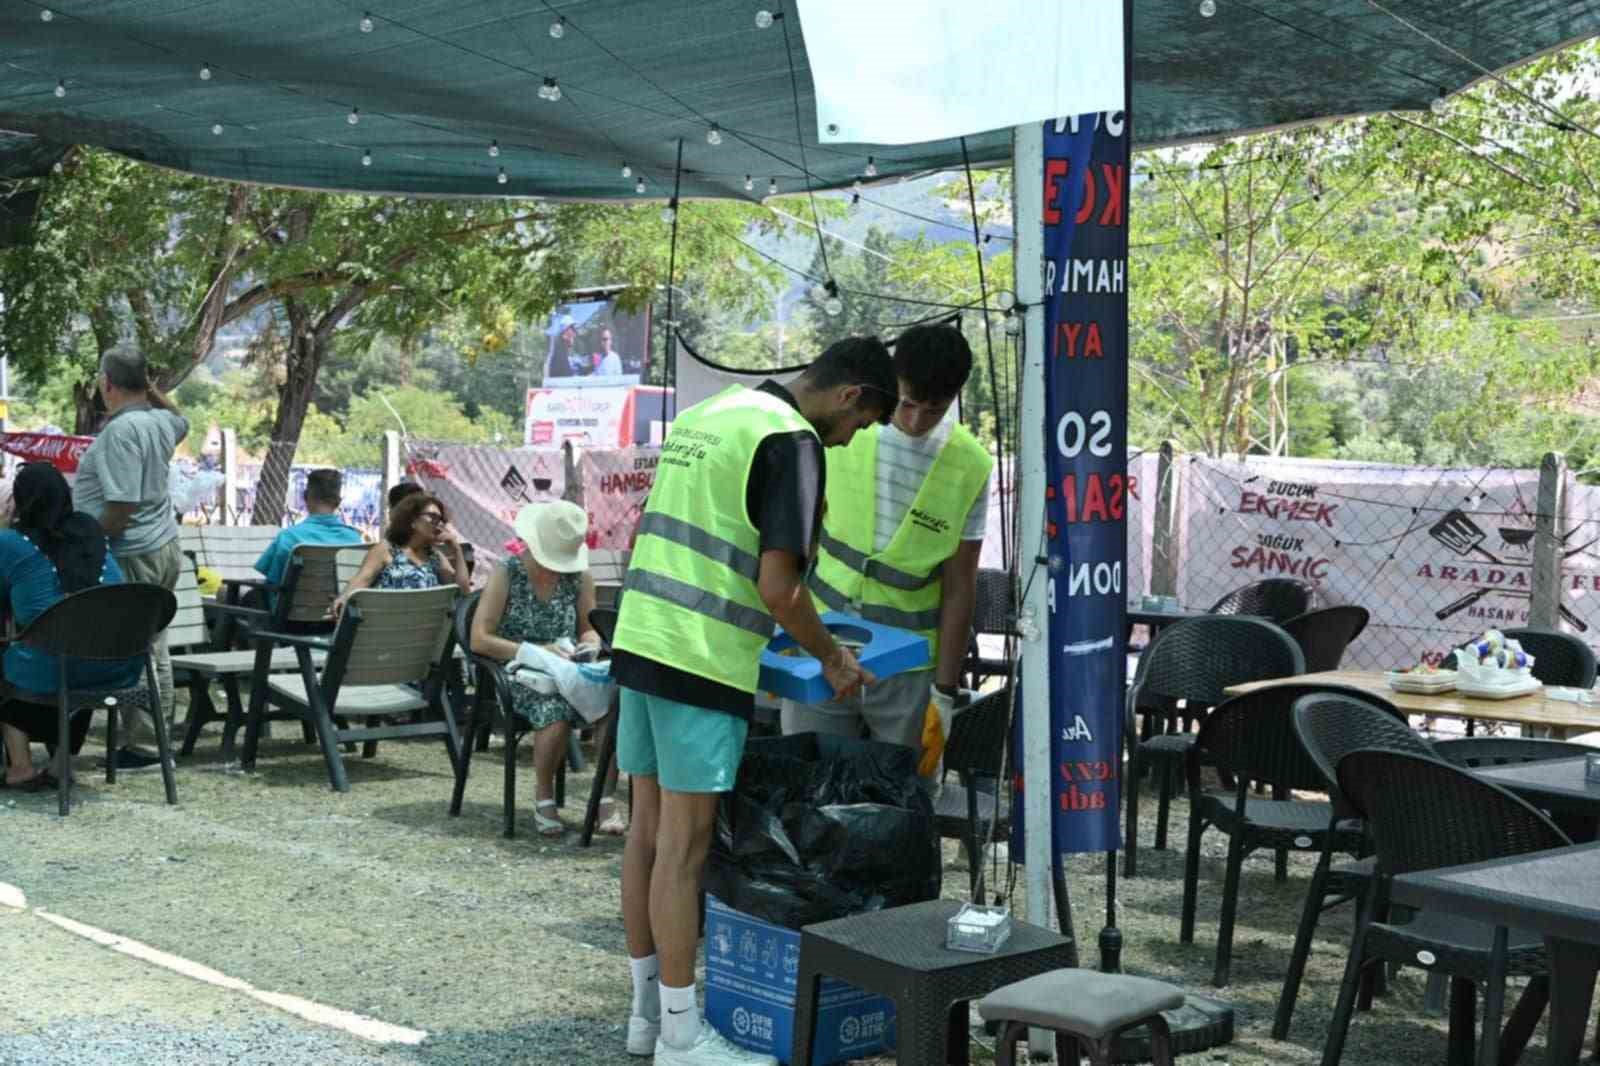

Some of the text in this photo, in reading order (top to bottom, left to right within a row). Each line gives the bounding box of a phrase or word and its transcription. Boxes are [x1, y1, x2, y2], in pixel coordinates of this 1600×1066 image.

[1266, 479, 1318, 499] SUCUK
[1238, 491, 1340, 527] EKMEK
[1416, 563, 1529, 587] ARADA
